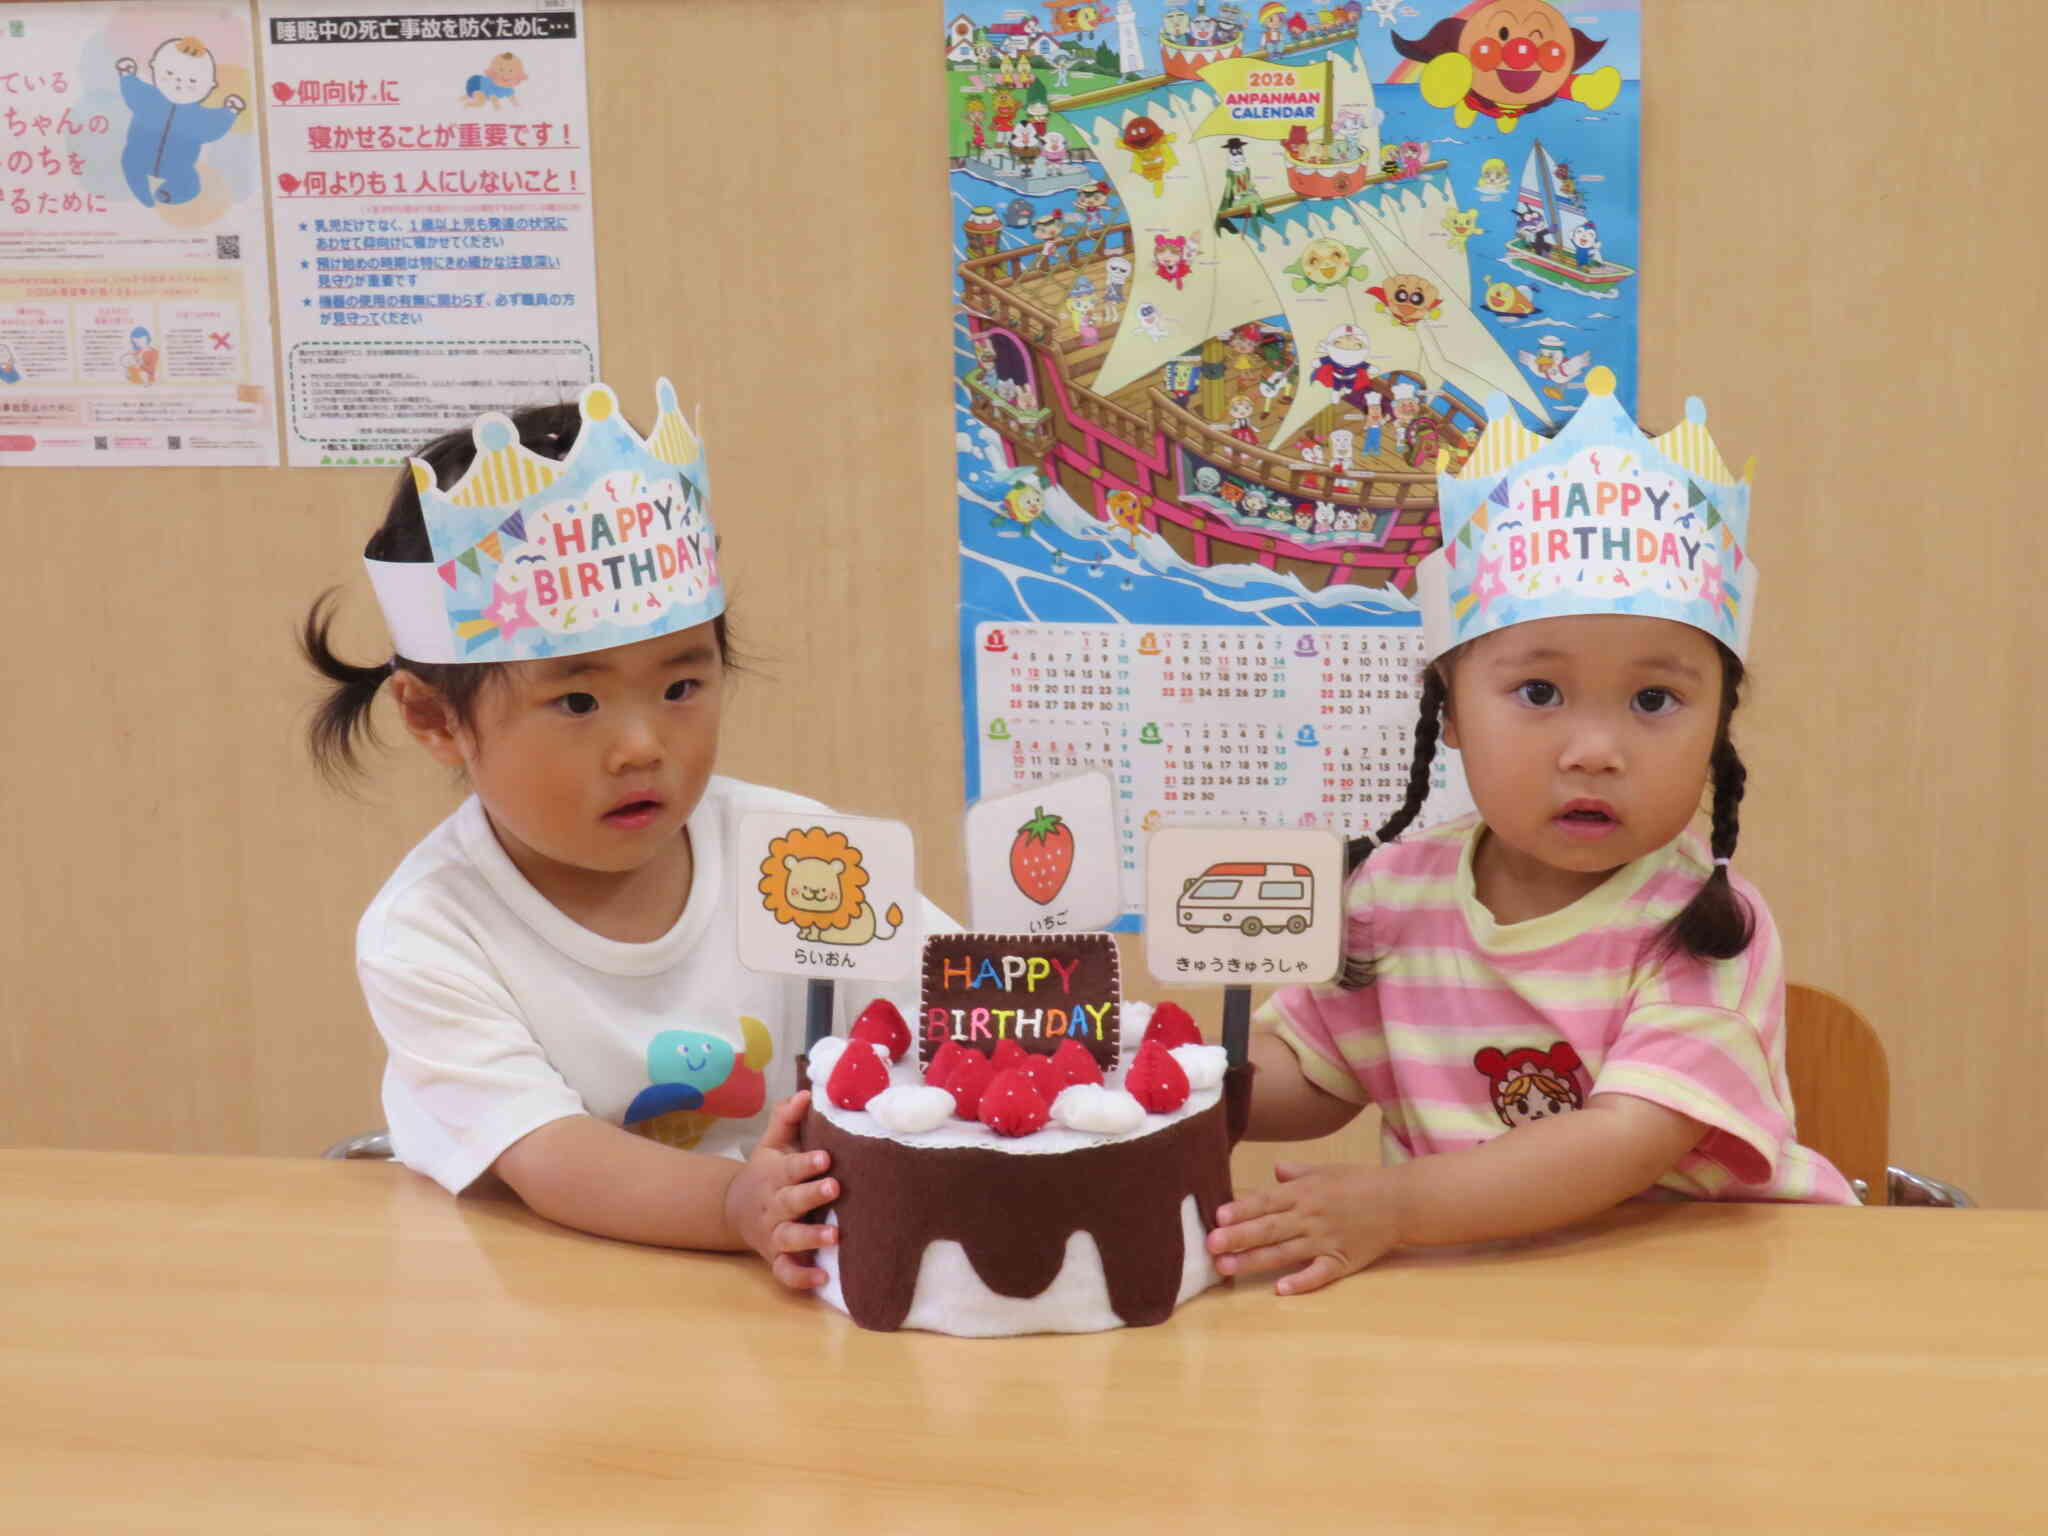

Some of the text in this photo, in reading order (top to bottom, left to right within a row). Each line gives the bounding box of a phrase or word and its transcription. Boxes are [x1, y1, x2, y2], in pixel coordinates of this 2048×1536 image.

[1249, 72, 1295, 87] 2026
[1226, 91, 1320, 105] ANPANMAN
[3, 106, 109, 136] ちゃんの
[1232, 106, 1315, 120] CALENDAR
[0, 187, 107, 214] るために
[1532, 481, 1670, 521] HAPPY
[553, 496, 672, 556] HAPPY
[1509, 526, 1700, 572] BIRTHDAY
[533, 532, 702, 606] BIRTHDAY
[1030, 908, 1068, 933] いちご
[794, 948, 856, 968] らいおん
[1176, 957, 1308, 973] きゅうきゅうしゃ
[944, 955, 1081, 993] HAPPY
[927, 1001, 1112, 1041] BIRTHDAY
